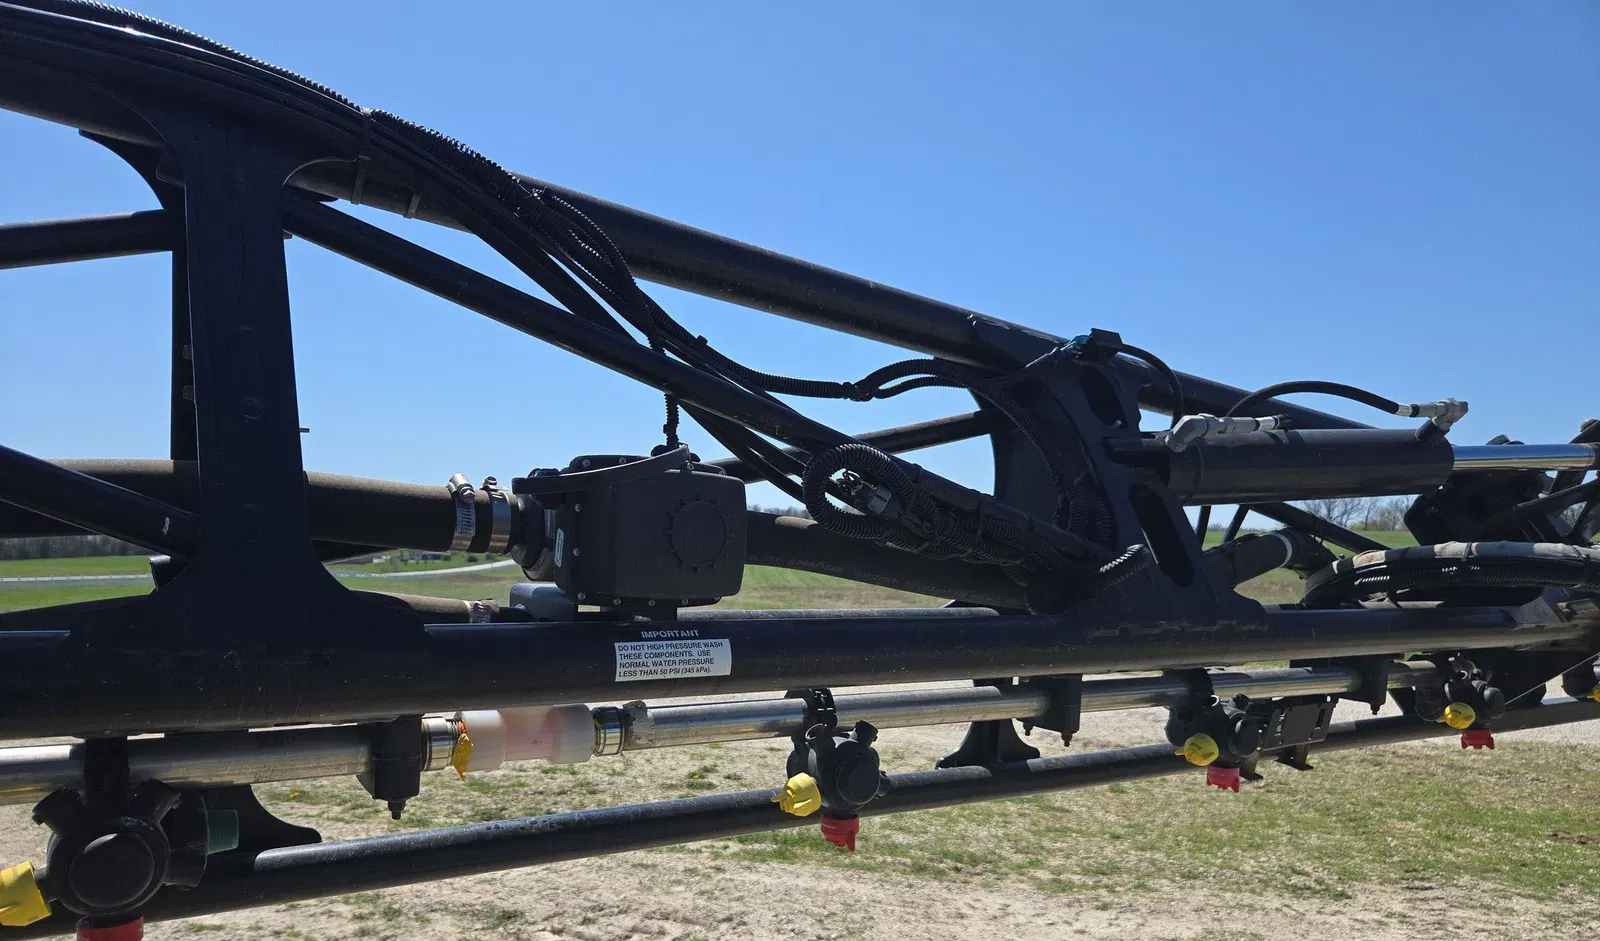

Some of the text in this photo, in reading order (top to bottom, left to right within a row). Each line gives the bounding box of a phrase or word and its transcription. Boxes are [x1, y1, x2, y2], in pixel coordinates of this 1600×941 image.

[641, 629, 699, 638] IMPORTANT
[647, 643, 664, 651] HIGH
[665, 642, 702, 650] PRESSURE
[619, 652, 643, 660] THESE
[644, 651, 694, 659] COMPONENTS.
[619, 658, 714, 669] NORMAL WATER PRESSURE
[618, 670, 637, 678] LESS
[681, 666, 695, 674] (345
[695, 666, 711, 674] kPa).
